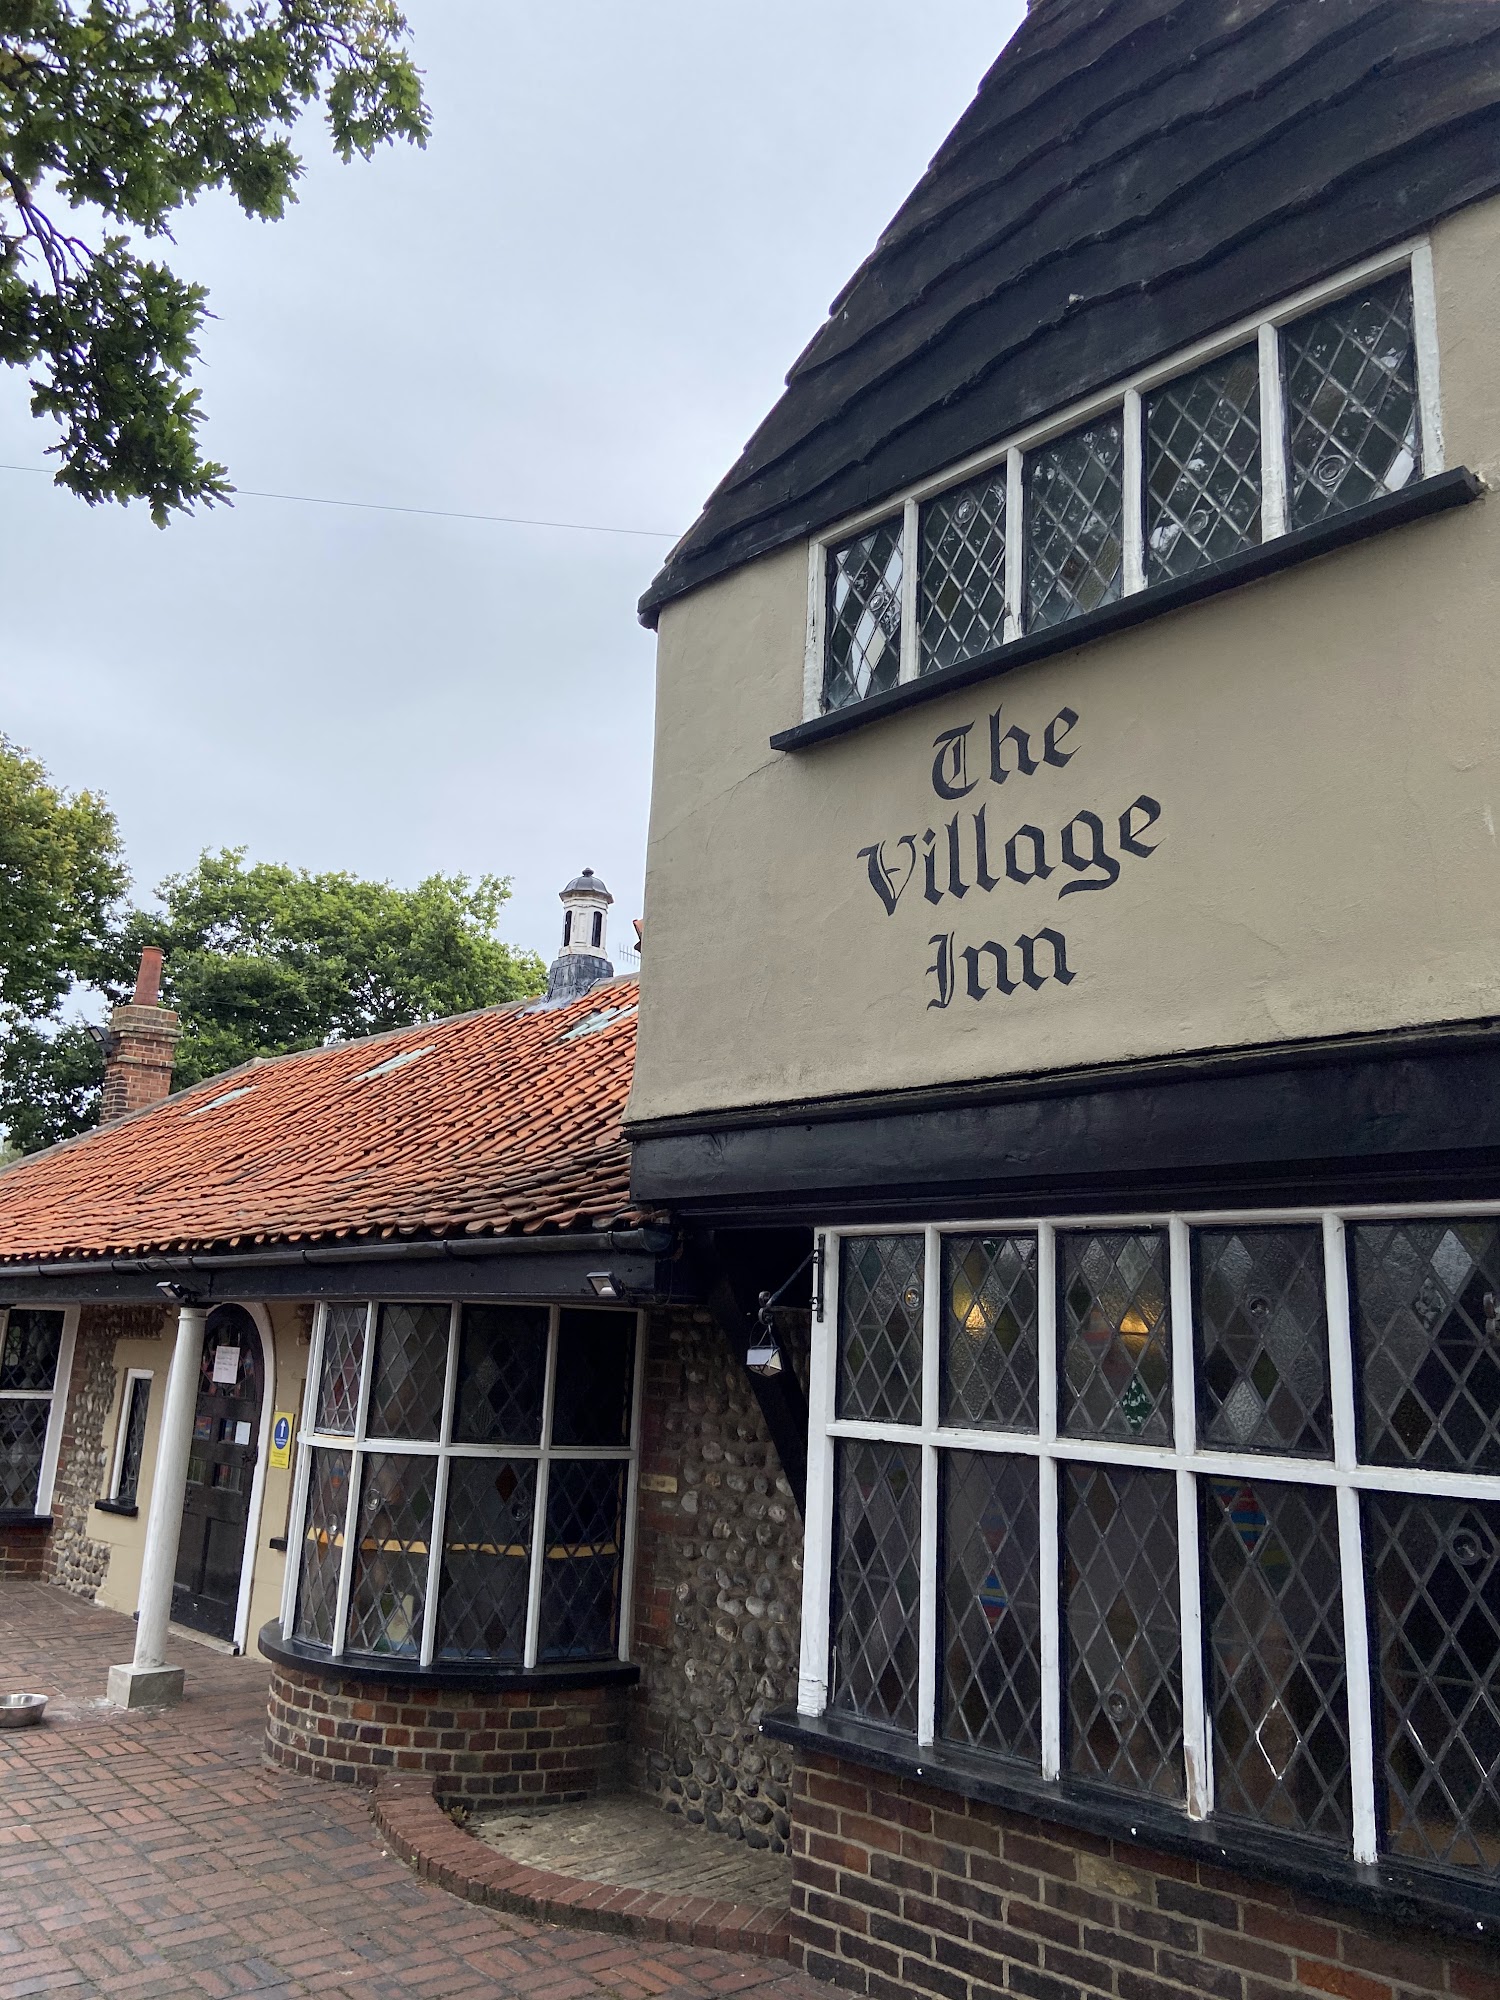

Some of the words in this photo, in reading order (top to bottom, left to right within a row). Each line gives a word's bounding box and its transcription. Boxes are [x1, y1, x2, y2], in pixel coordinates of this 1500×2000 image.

[931, 703, 1082, 800] The
[856, 794, 1167, 917] Village
[925, 927, 1077, 1011] Inn
